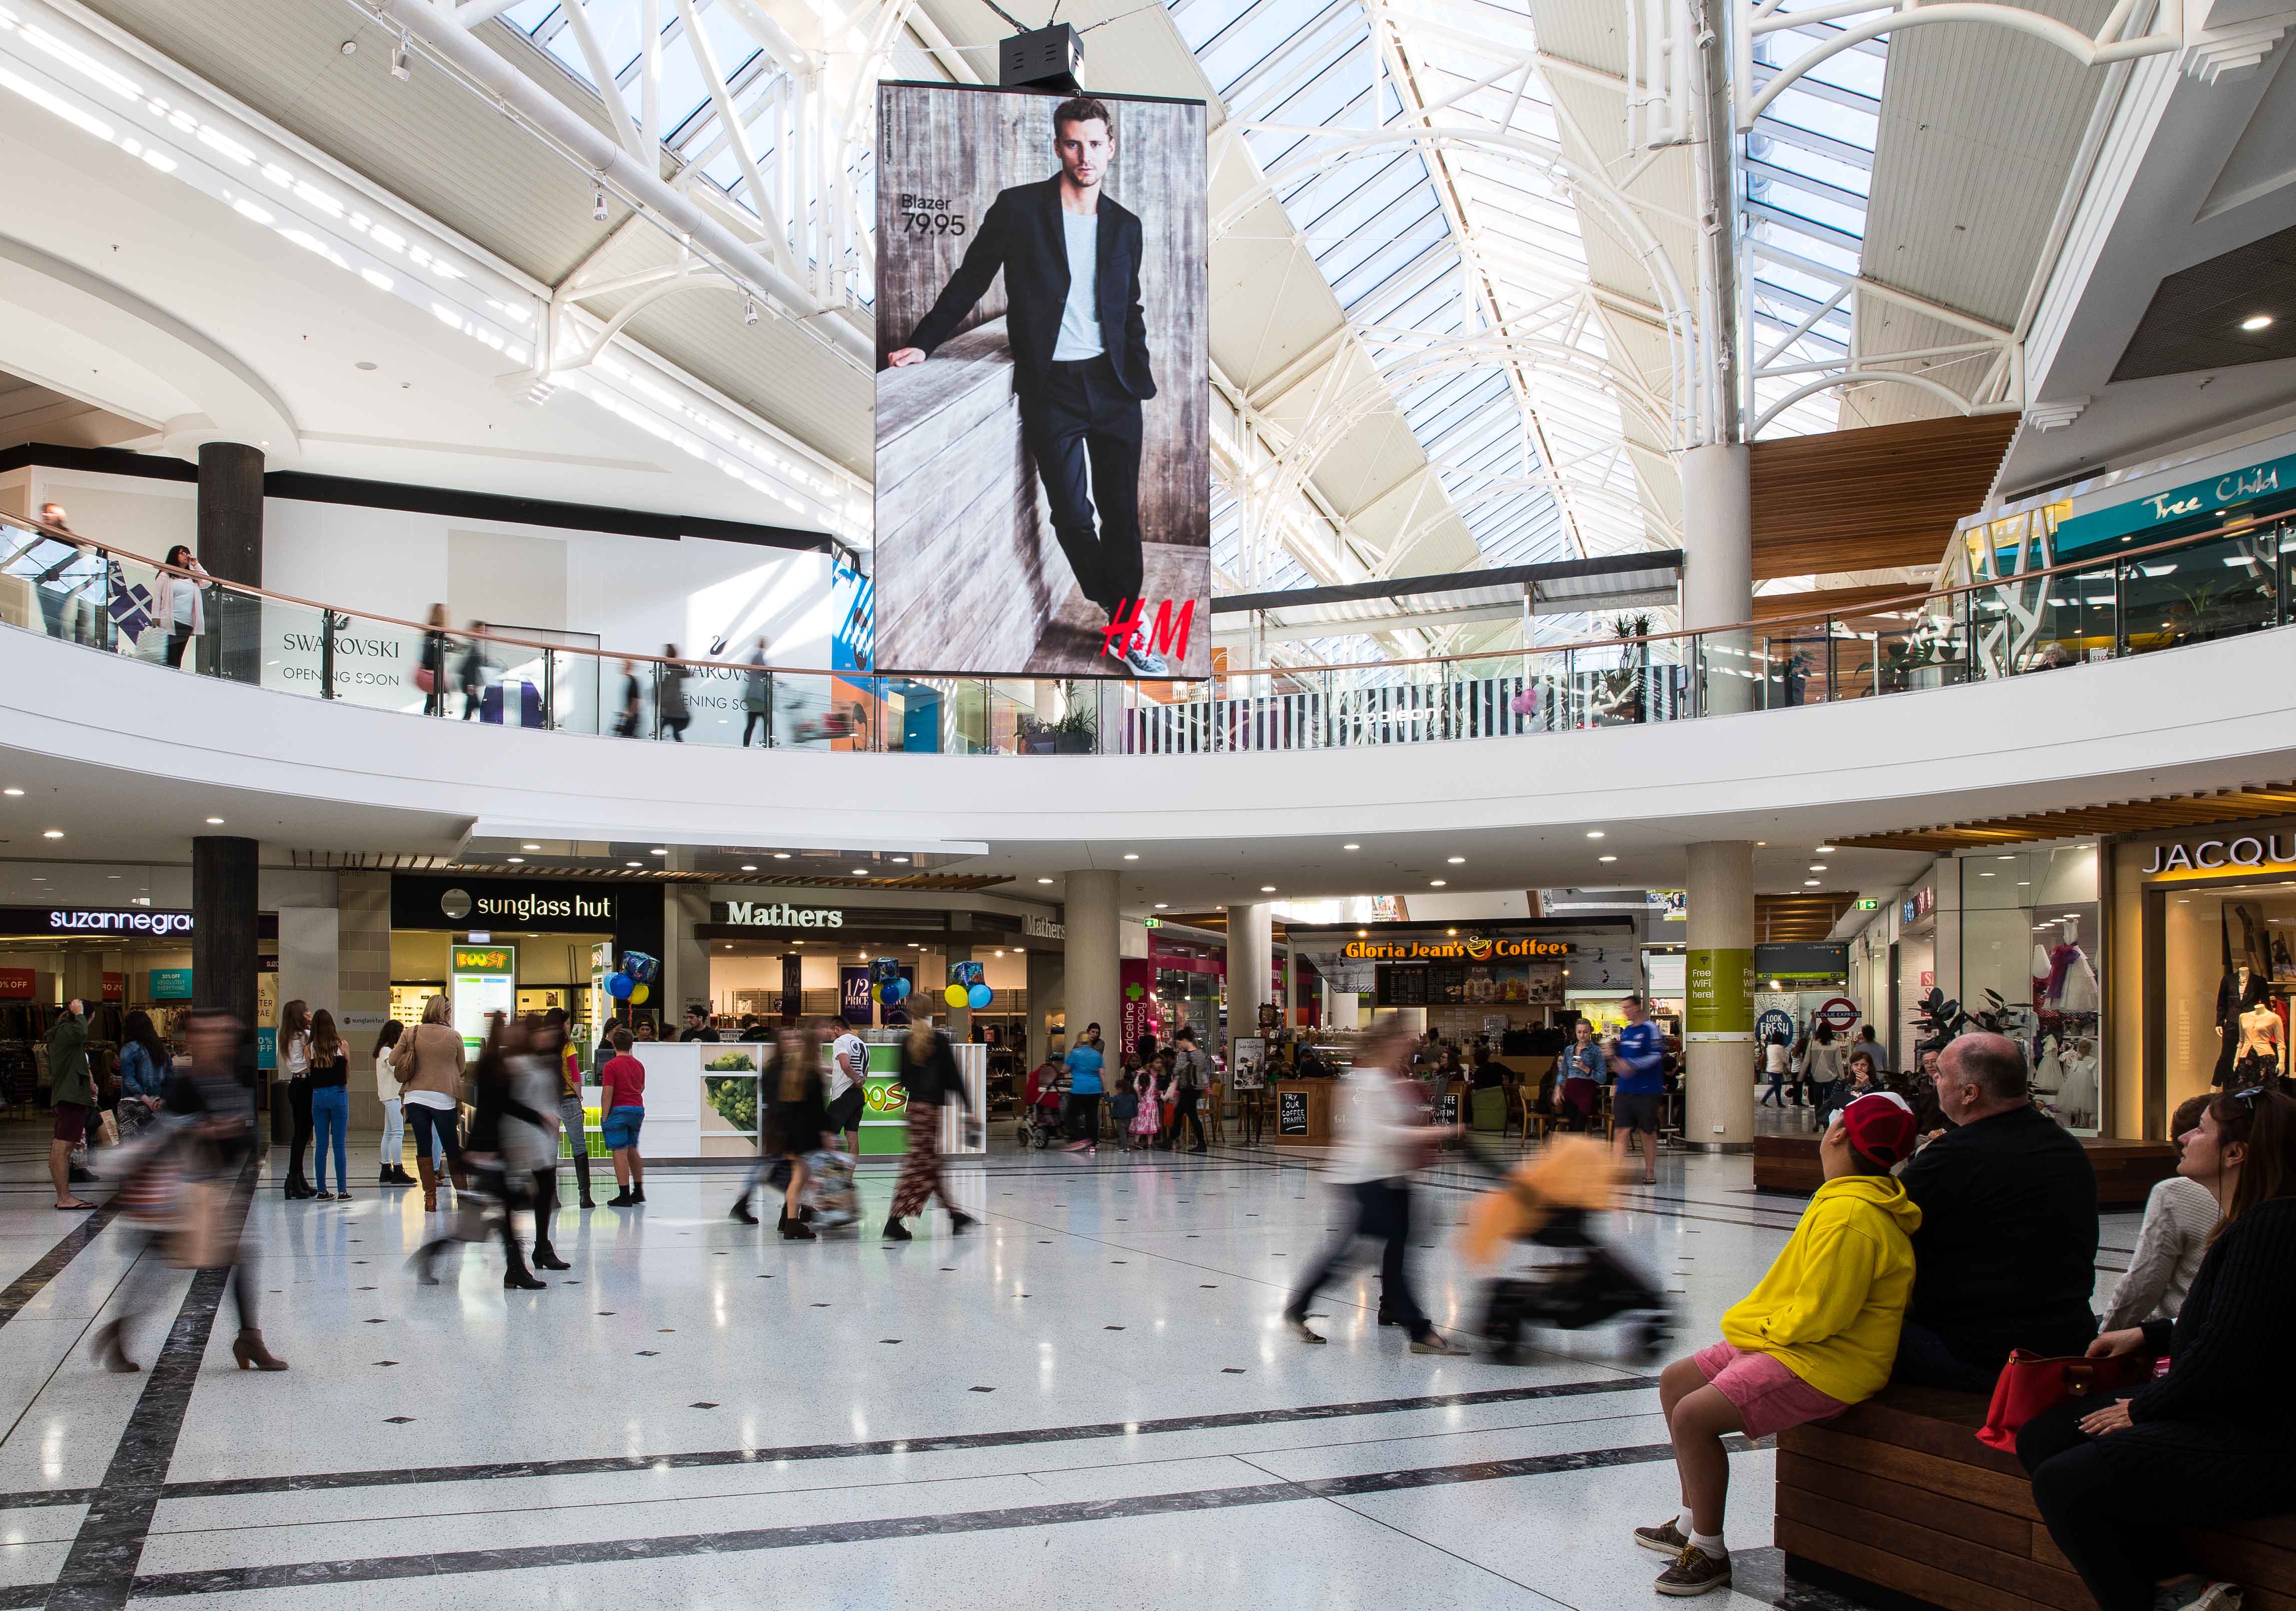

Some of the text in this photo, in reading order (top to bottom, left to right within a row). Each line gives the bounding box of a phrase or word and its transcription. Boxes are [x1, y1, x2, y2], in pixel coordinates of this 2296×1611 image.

[902, 194, 952, 210] Blazer
[901, 212, 965, 236] 79.95
[2142, 466, 2278, 519] Tree Child
[1099, 597, 1195, 662] H&M
[284, 633, 400, 658] SWAROVSKI
[284, 667, 399, 686] OPENNG SOON
[682, 694, 750, 711] ENING SO
[478, 894, 611, 921] sunglass hut
[726, 901, 843, 928] Mathers
[50, 912, 194, 935] suzannegra
[1026, 914, 1065, 940] Mathers
[1346, 939, 1567, 958] Gloria Jean's Coffees
[456, 952, 508, 969] BOOST
[784, 966, 800, 987] 1/2
[1692, 969, 1711, 978] Free
[1744, 969, 1754, 977] Fre
[11, 981, 28, 989] OFF
[845, 978, 869, 997] 1/2
[1692, 979, 1711, 988] WiFi
[258, 999, 273, 1007] TER
[845, 996, 869, 1005] PRICE
[1692, 990, 1714, 999] here!
[1766, 1014, 1783, 1023] LOOK
[1124, 1002, 1136, 1054] priceline
[1760, 1022, 1789, 1036] FRESH
[258, 1037, 273, 1045] 0%
[1283, 1116, 1306, 1124] FRAPPES
